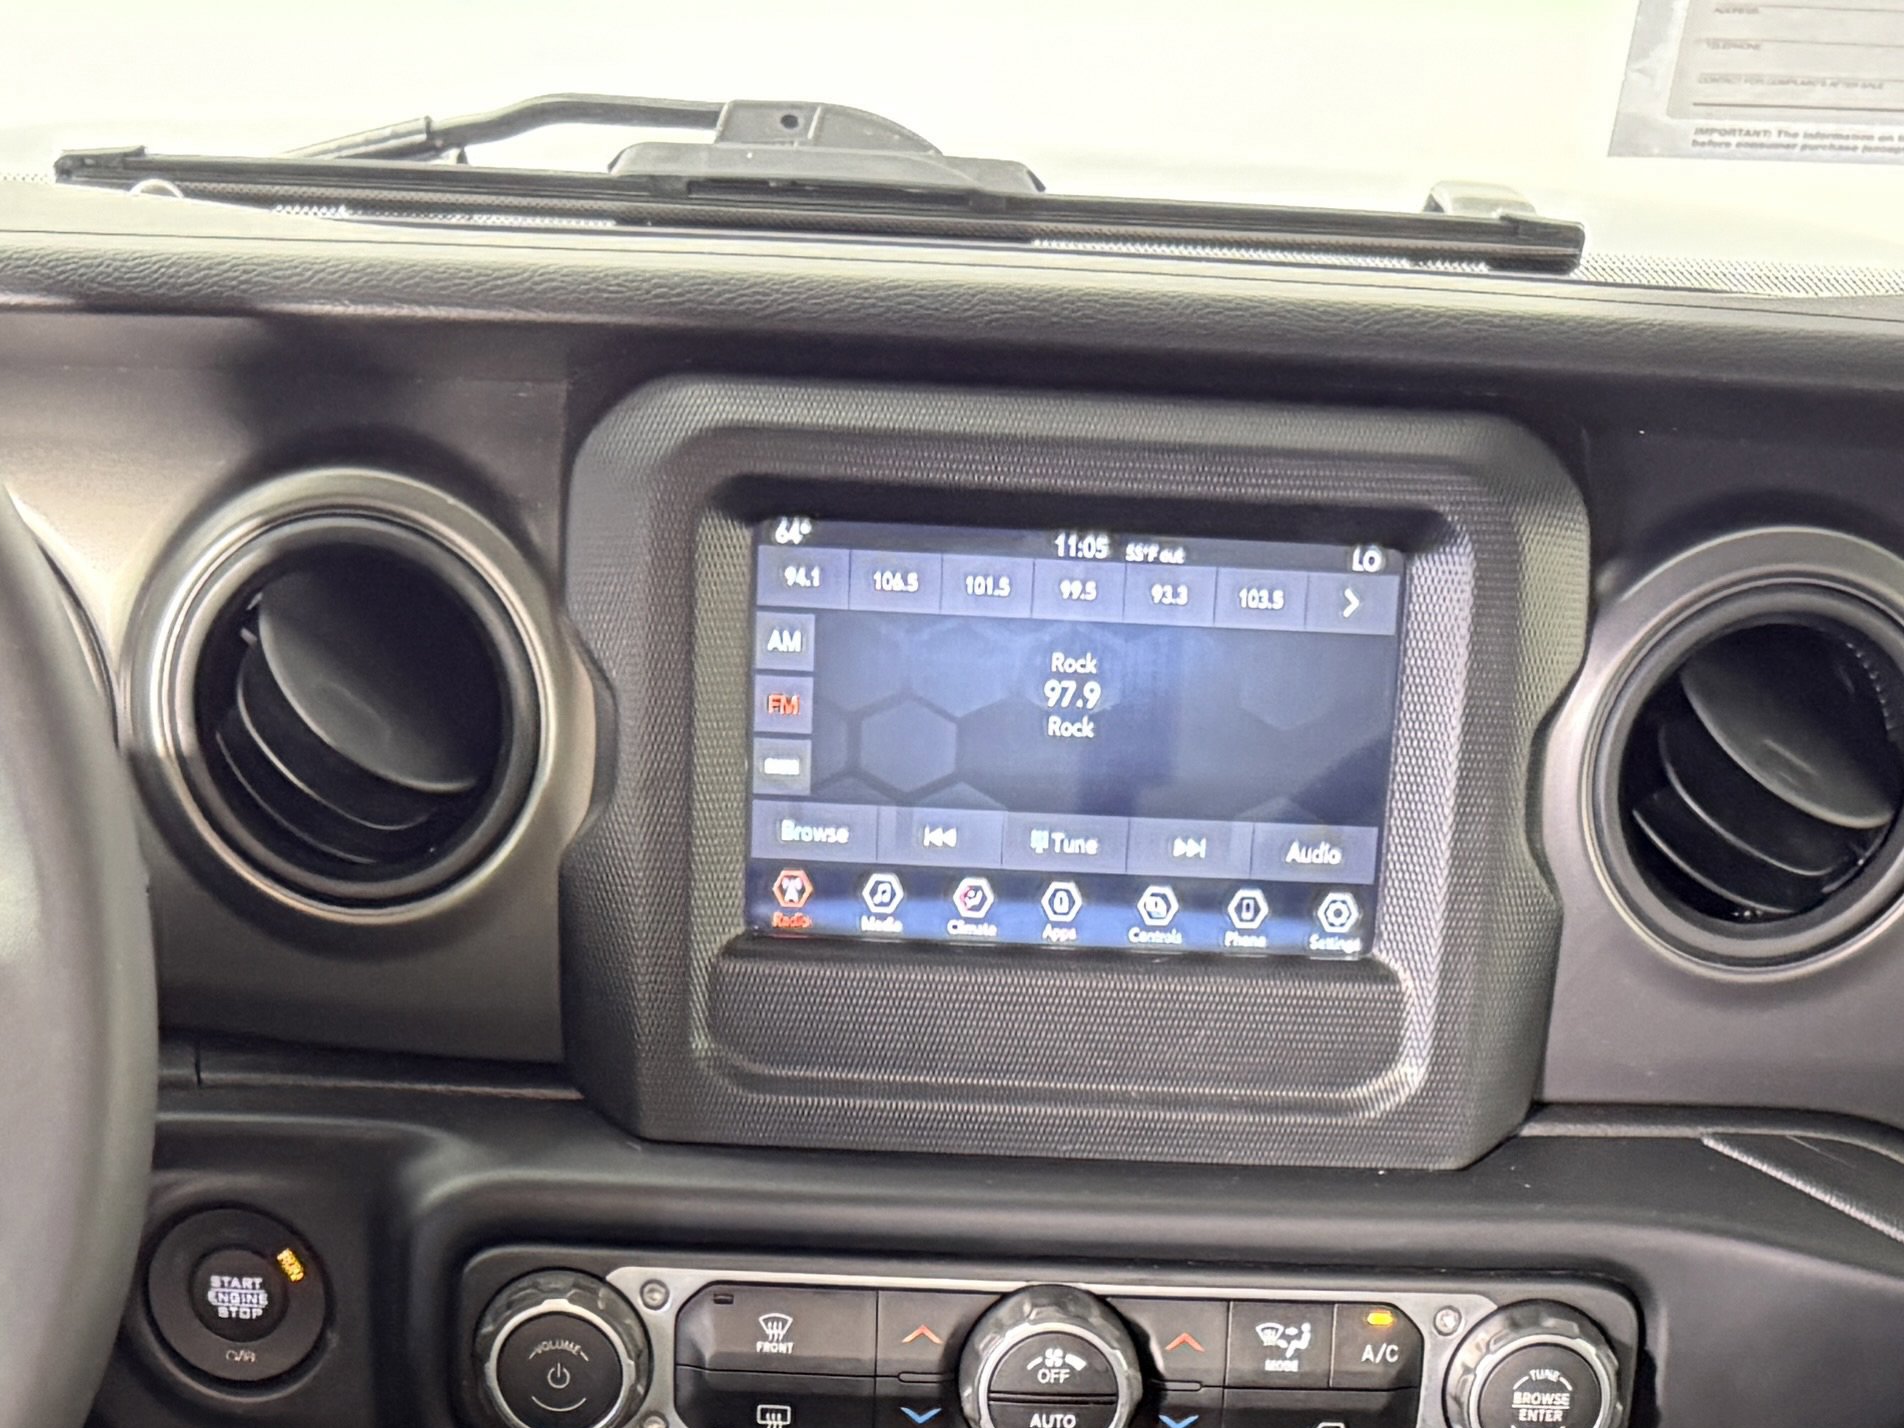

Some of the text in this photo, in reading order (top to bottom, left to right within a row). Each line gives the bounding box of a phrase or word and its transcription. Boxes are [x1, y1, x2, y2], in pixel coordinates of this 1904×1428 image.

[1054, 533, 1110, 559] 11:05
[1352, 546, 1383, 573] LO
[784, 565, 820, 588] 94.1
[873, 570, 919, 592] 106.5
[965, 575, 1011, 597] 101.5
[1059, 579, 1097, 601] 99.5
[1151, 584, 1188, 606] 93.3
[1239, 588, 1284, 610] 103.5
[767, 629, 802, 653] AM
[1050, 652, 1098, 675] Rock
[768, 693, 800, 716] FM
[1043, 679, 1102, 711] 97.9
[1046, 716, 1096, 739] Rock
[780, 819, 849, 844] Browse
[1051, 831, 1099, 855] Tune
[1286, 839, 1343, 865] Audio
[771, 911, 813, 929] Radio
[860, 914, 903, 934] Media
[947, 917, 998, 937] Climate
[1042, 922, 1078, 943] Apps
[1127, 925, 1183, 946] Controls
[1224, 930, 1268, 949] Phone
[1309, 934, 1362, 954] Settings
[210, 1275, 263, 1290] START
[207, 1290, 268, 1308] ENGINE
[217, 1306, 263, 1320] STOP
[534, 1338, 583, 1355] VOLUME
[755, 1340, 794, 1354] FRONT
[1362, 1343, 1399, 1364] A/C
[1264, 1359, 1299, 1372] MODE
[1529, 1367, 1560, 1383] TUNE
[1037, 1369, 1070, 1384] OFF
[1512, 1392, 1571, 1406] BROWSE
[1518, 1408, 1563, 1423] ENTER
